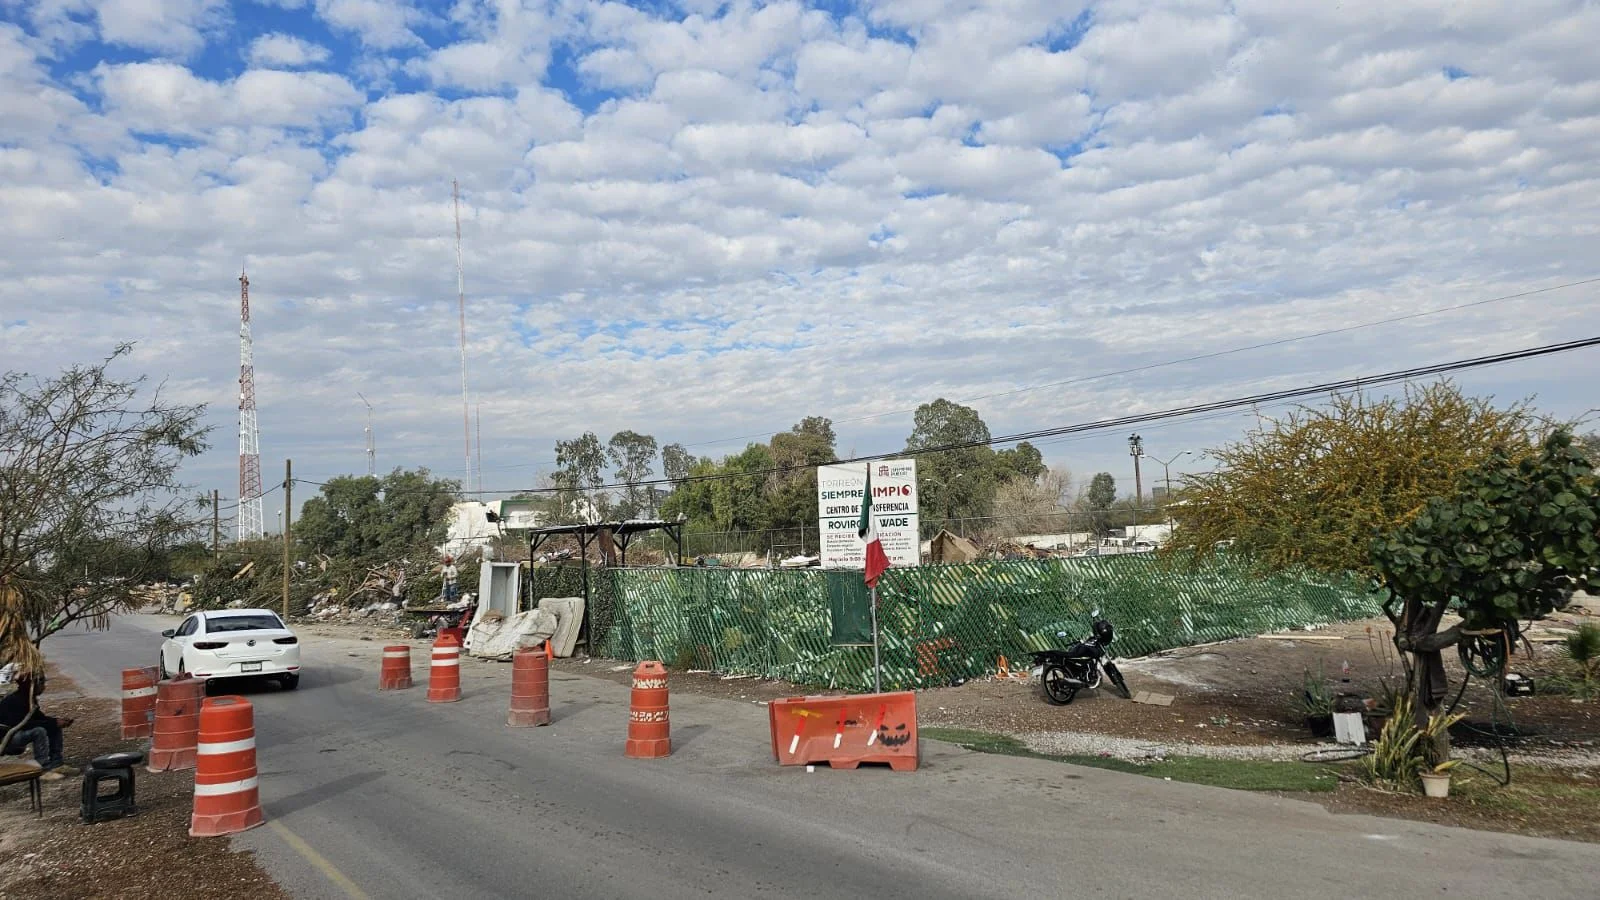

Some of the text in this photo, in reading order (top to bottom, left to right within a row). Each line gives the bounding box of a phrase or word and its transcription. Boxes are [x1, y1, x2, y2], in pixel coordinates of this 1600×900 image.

[822, 478, 863, 488] TORREÓN
[821, 489, 864, 500] SIEMPRE
[826, 505, 849, 515] CENTRO
[851, 505, 859, 513] DE
[879, 517, 909, 528] WADE
